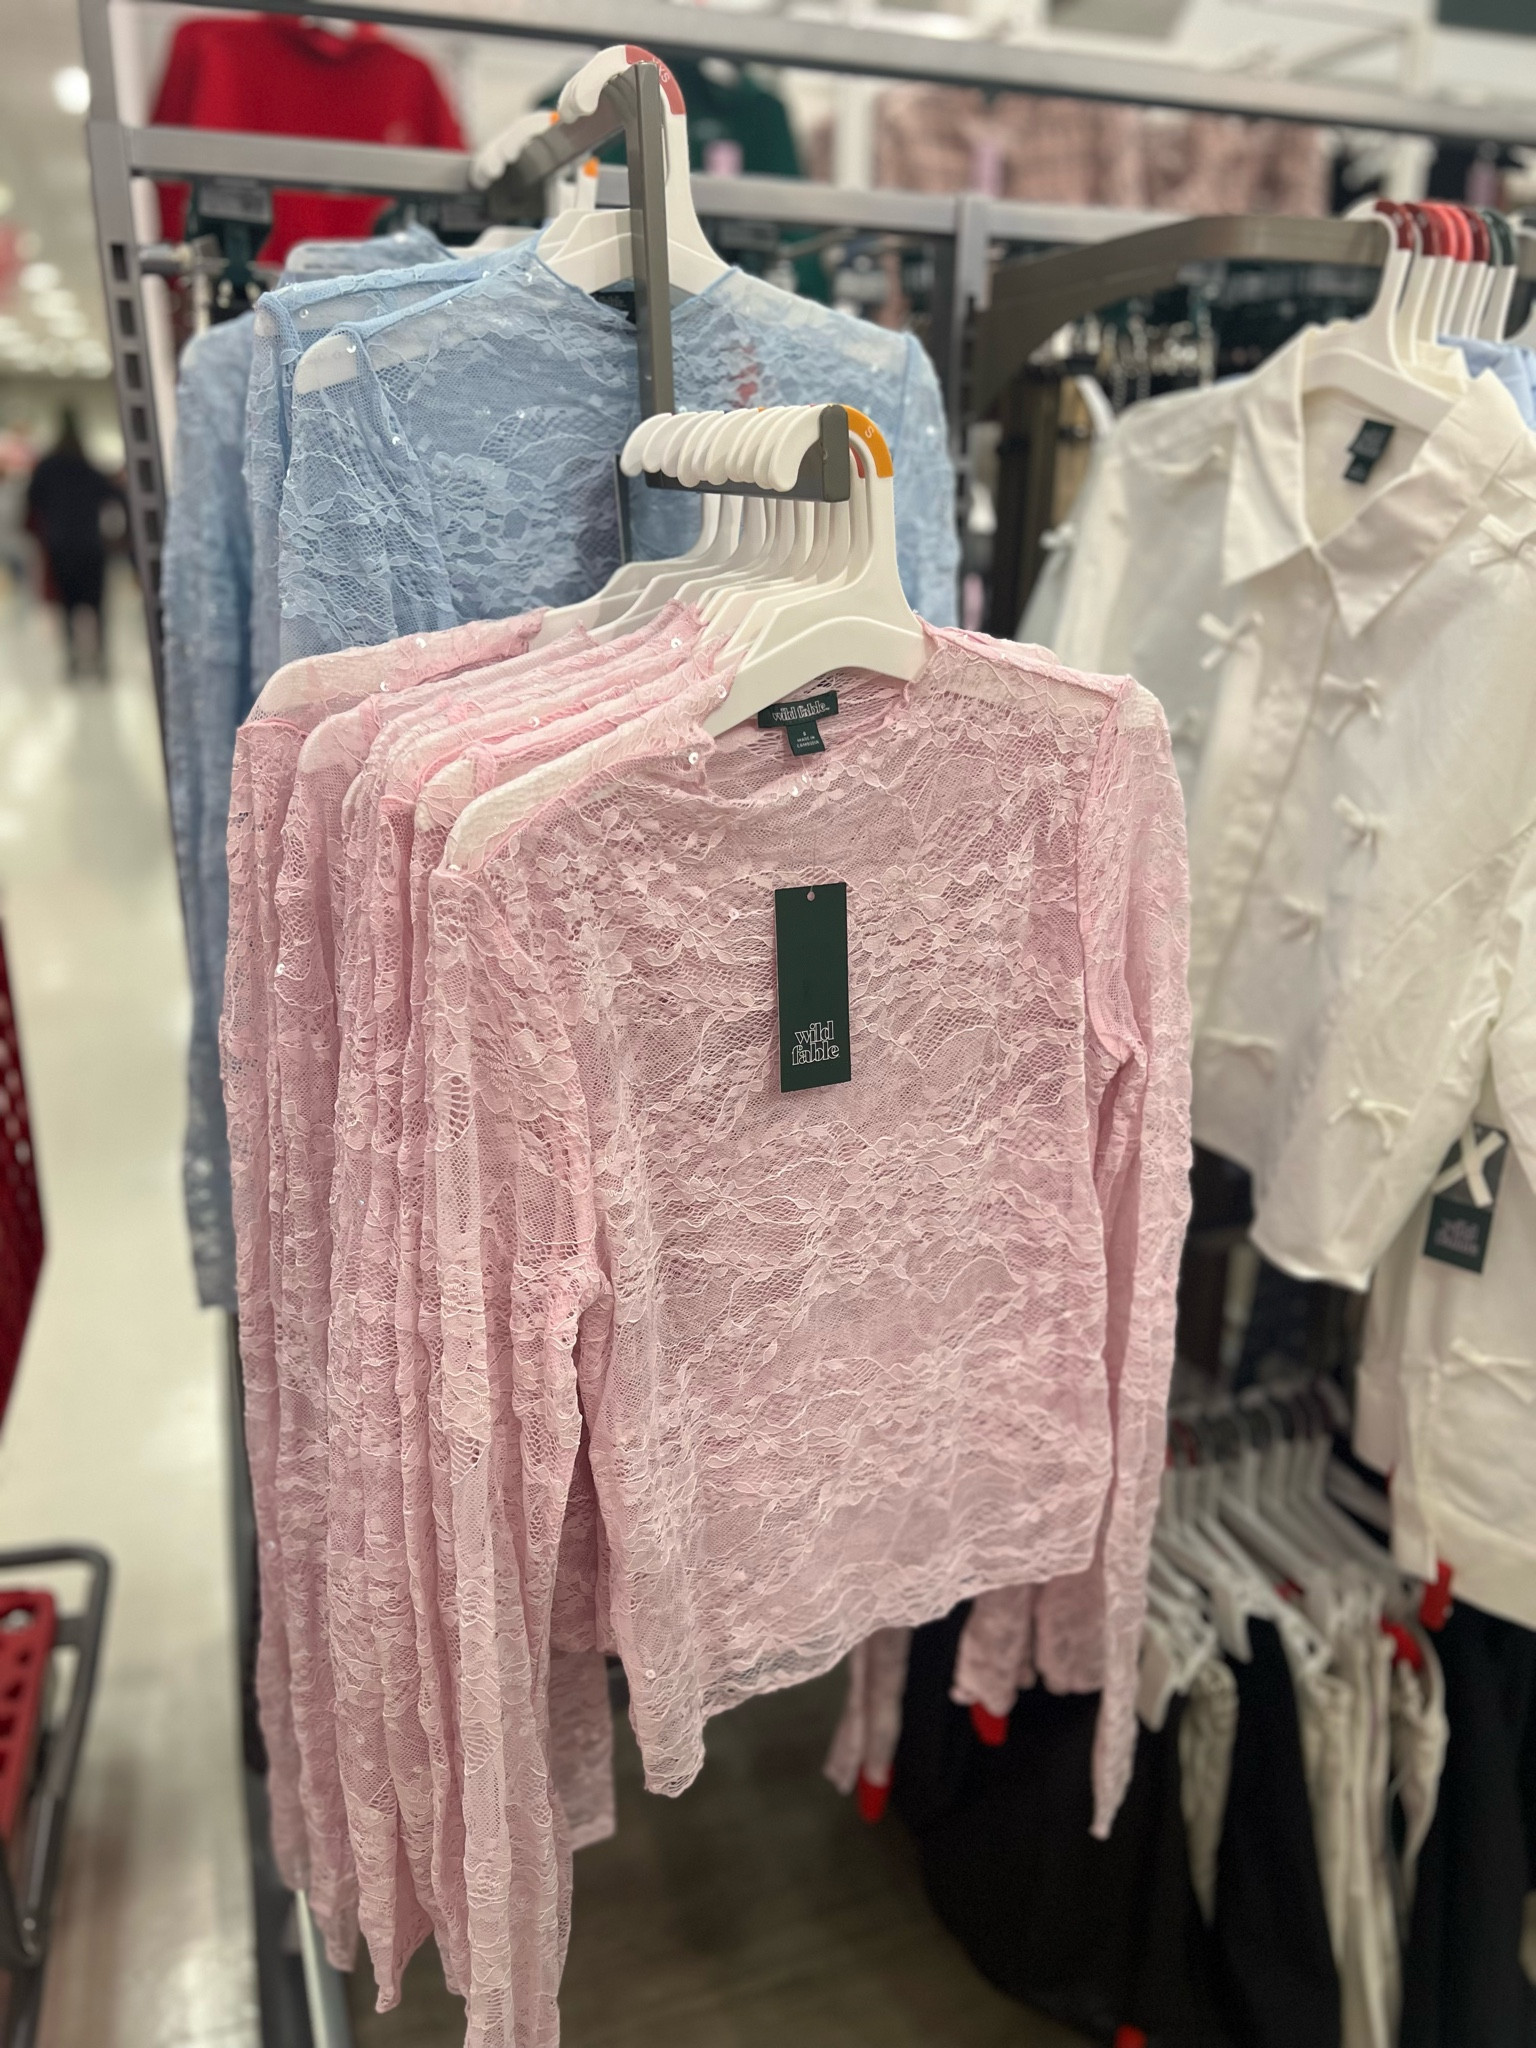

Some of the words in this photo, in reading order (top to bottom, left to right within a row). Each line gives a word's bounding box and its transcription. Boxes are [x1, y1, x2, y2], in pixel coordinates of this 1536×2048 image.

[864, 426, 875, 438] S
[772, 706, 798, 721] wild
[797, 700, 826, 718] fable
[795, 1020, 834, 1044] wild
[792, 1040, 840, 1066] fable
